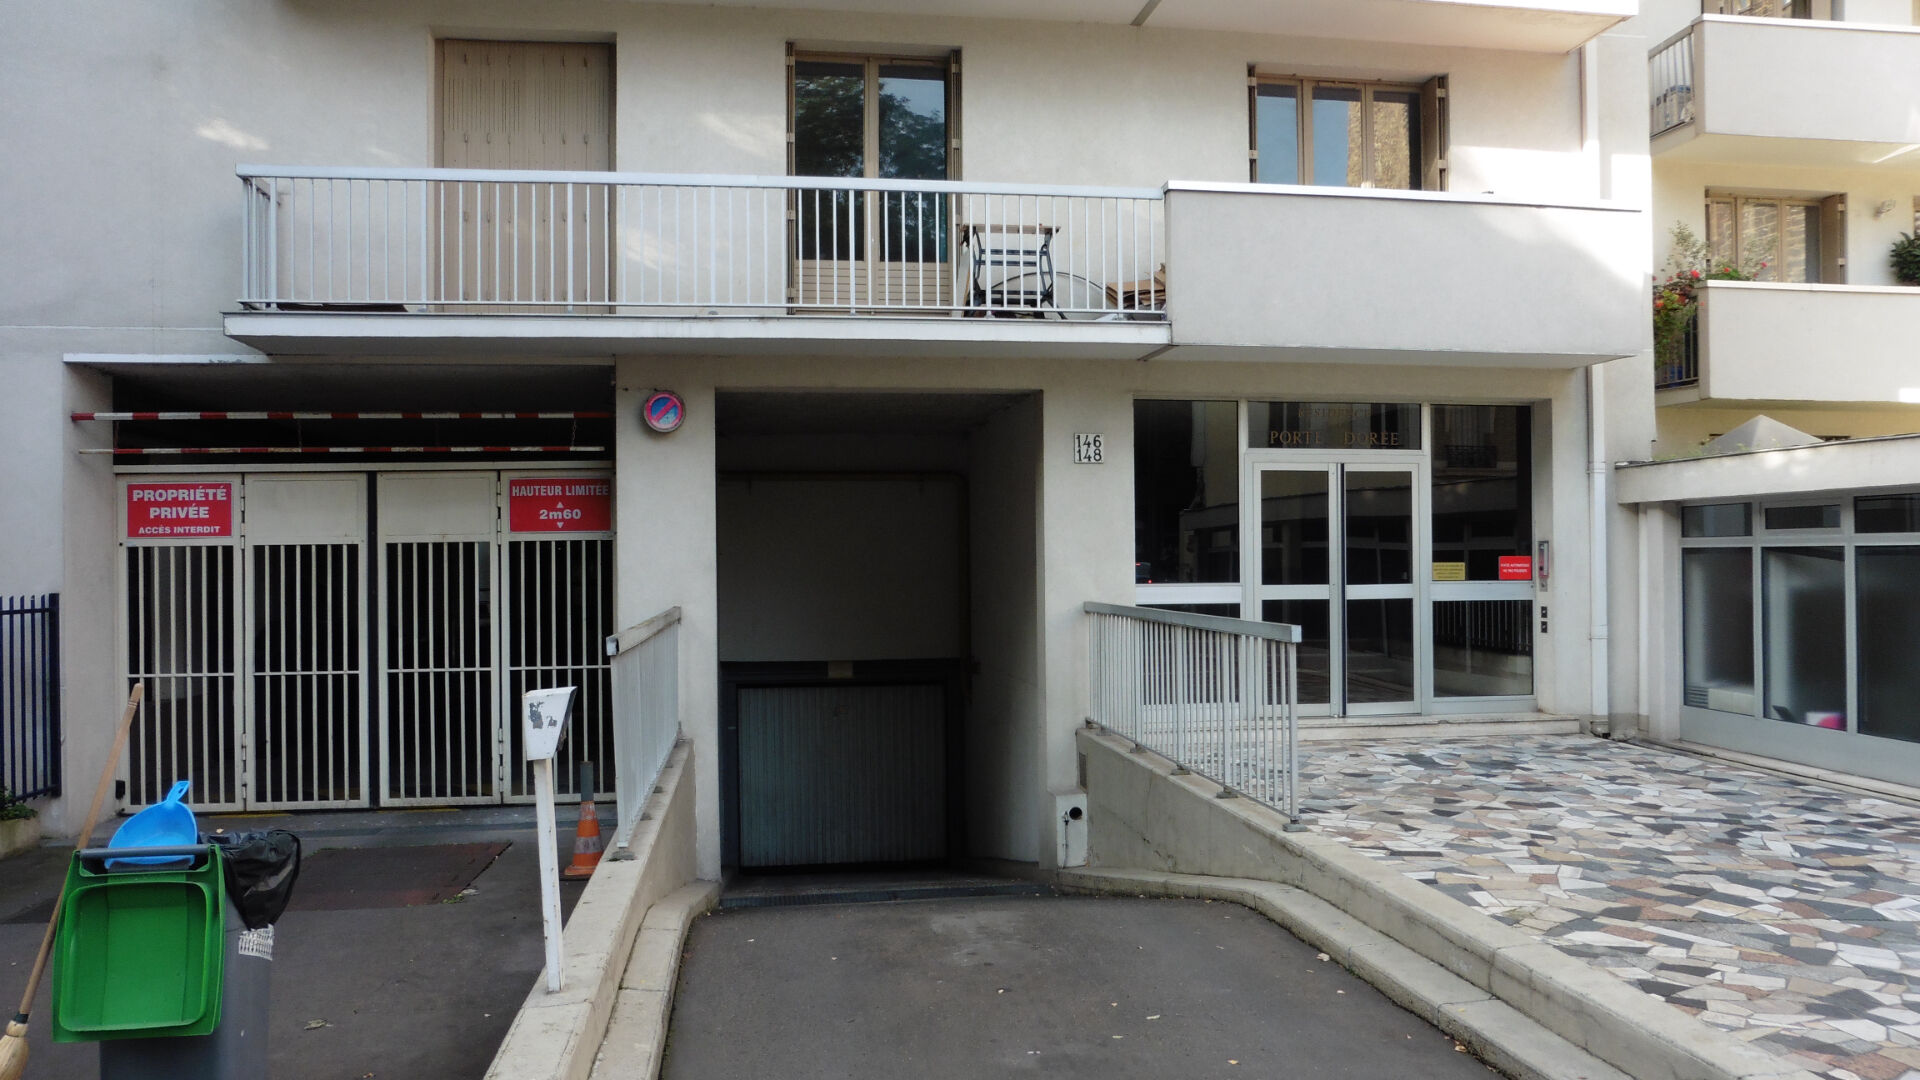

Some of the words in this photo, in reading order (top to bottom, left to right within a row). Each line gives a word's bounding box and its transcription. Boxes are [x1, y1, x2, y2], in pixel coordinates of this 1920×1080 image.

[1075, 434, 1102, 449] 146
[1270, 430, 1322, 445] PORTE
[1076, 448, 1102, 462] 148
[132, 485, 227, 502] PROPRIÉTÉ
[512, 485, 562, 497] HAUTEUR
[565, 483, 609, 496] LIMITÉE
[149, 503, 210, 519] PRIVÉE
[539, 508, 582, 520] 2m60
[138, 524, 171, 534] ACCÈS
[173, 525, 221, 534] INTERDIT
